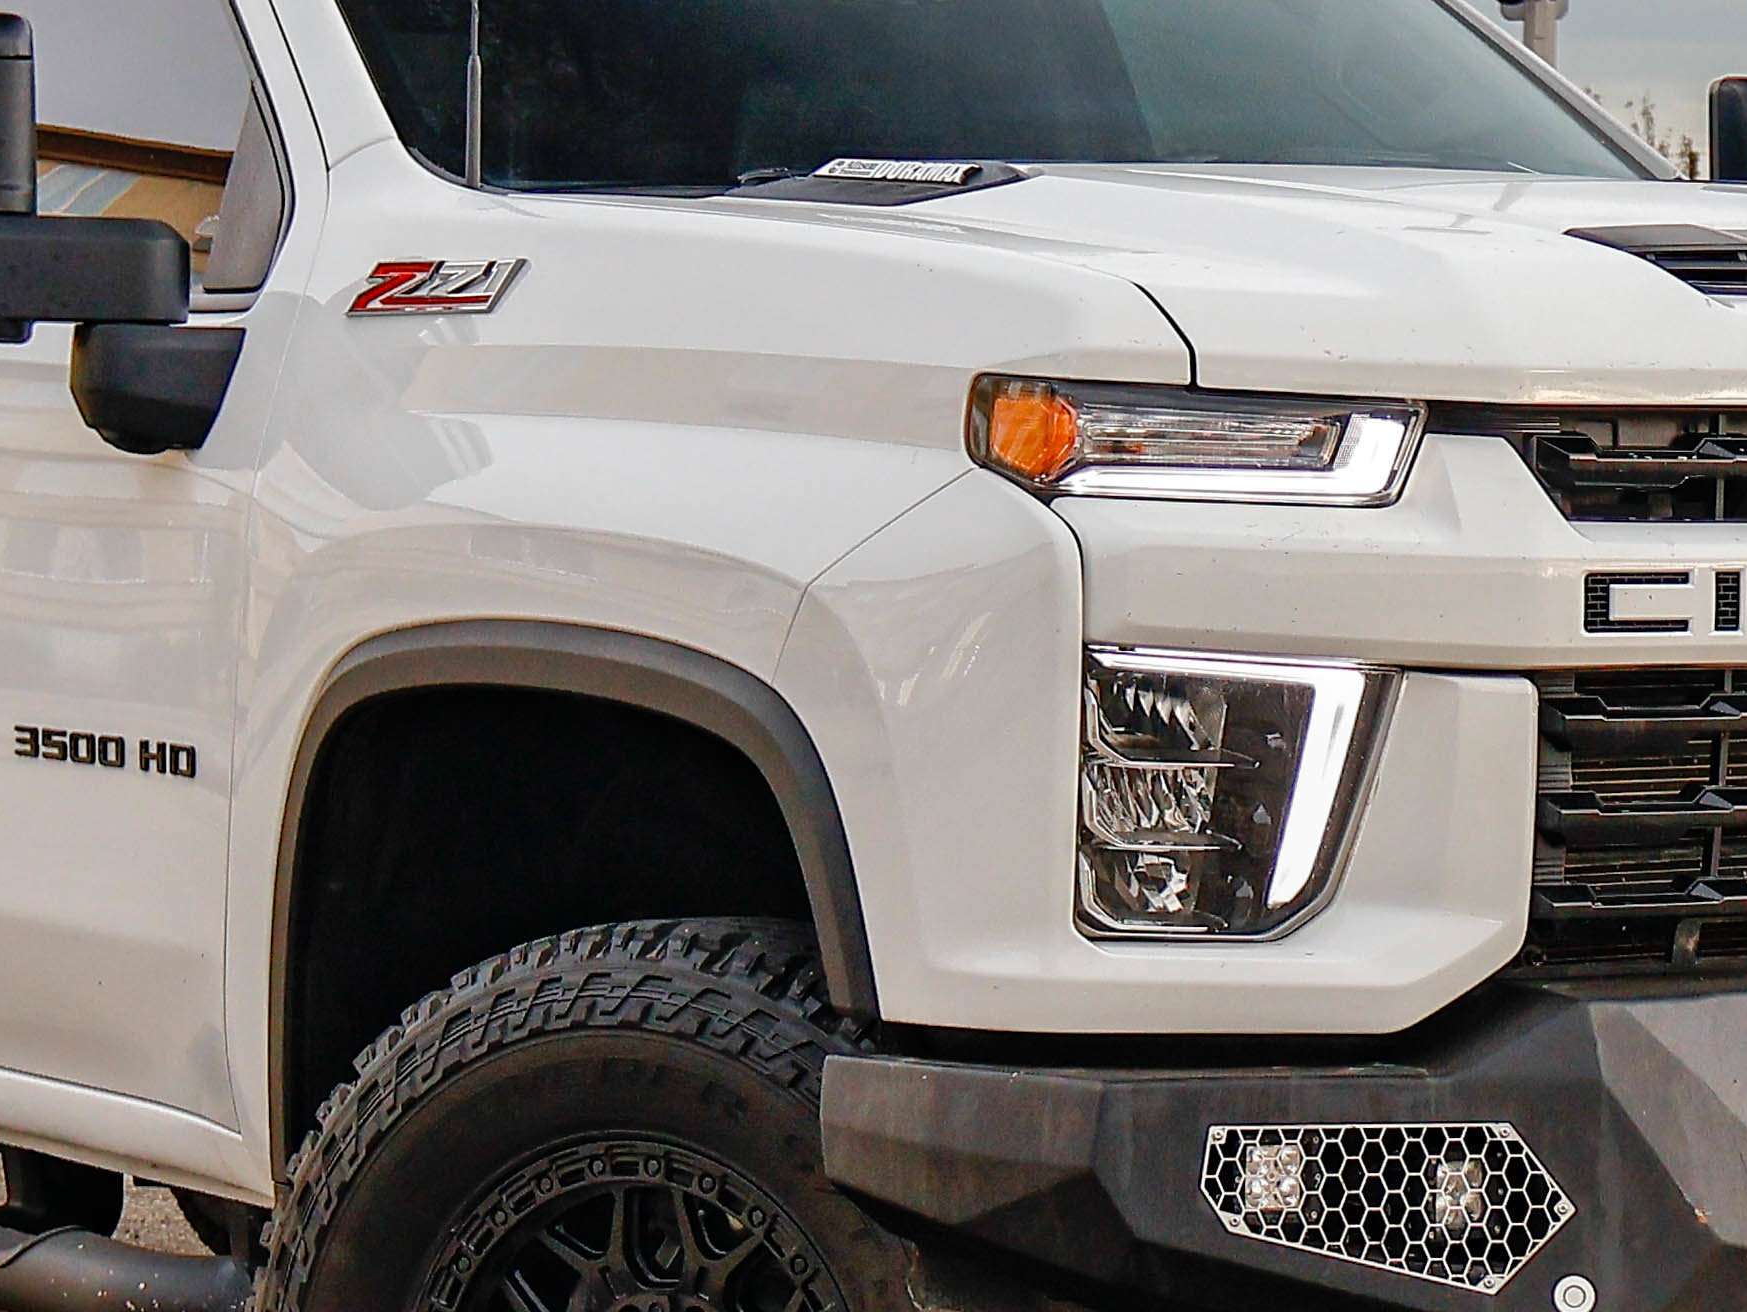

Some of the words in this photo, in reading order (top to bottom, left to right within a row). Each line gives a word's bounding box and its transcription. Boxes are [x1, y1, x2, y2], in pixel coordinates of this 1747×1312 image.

[874, 160, 982, 185] DURAMAX
[344, 257, 529, 318] Z71
[13, 724, 126, 768] 3500
[138, 738, 197, 779] HD
